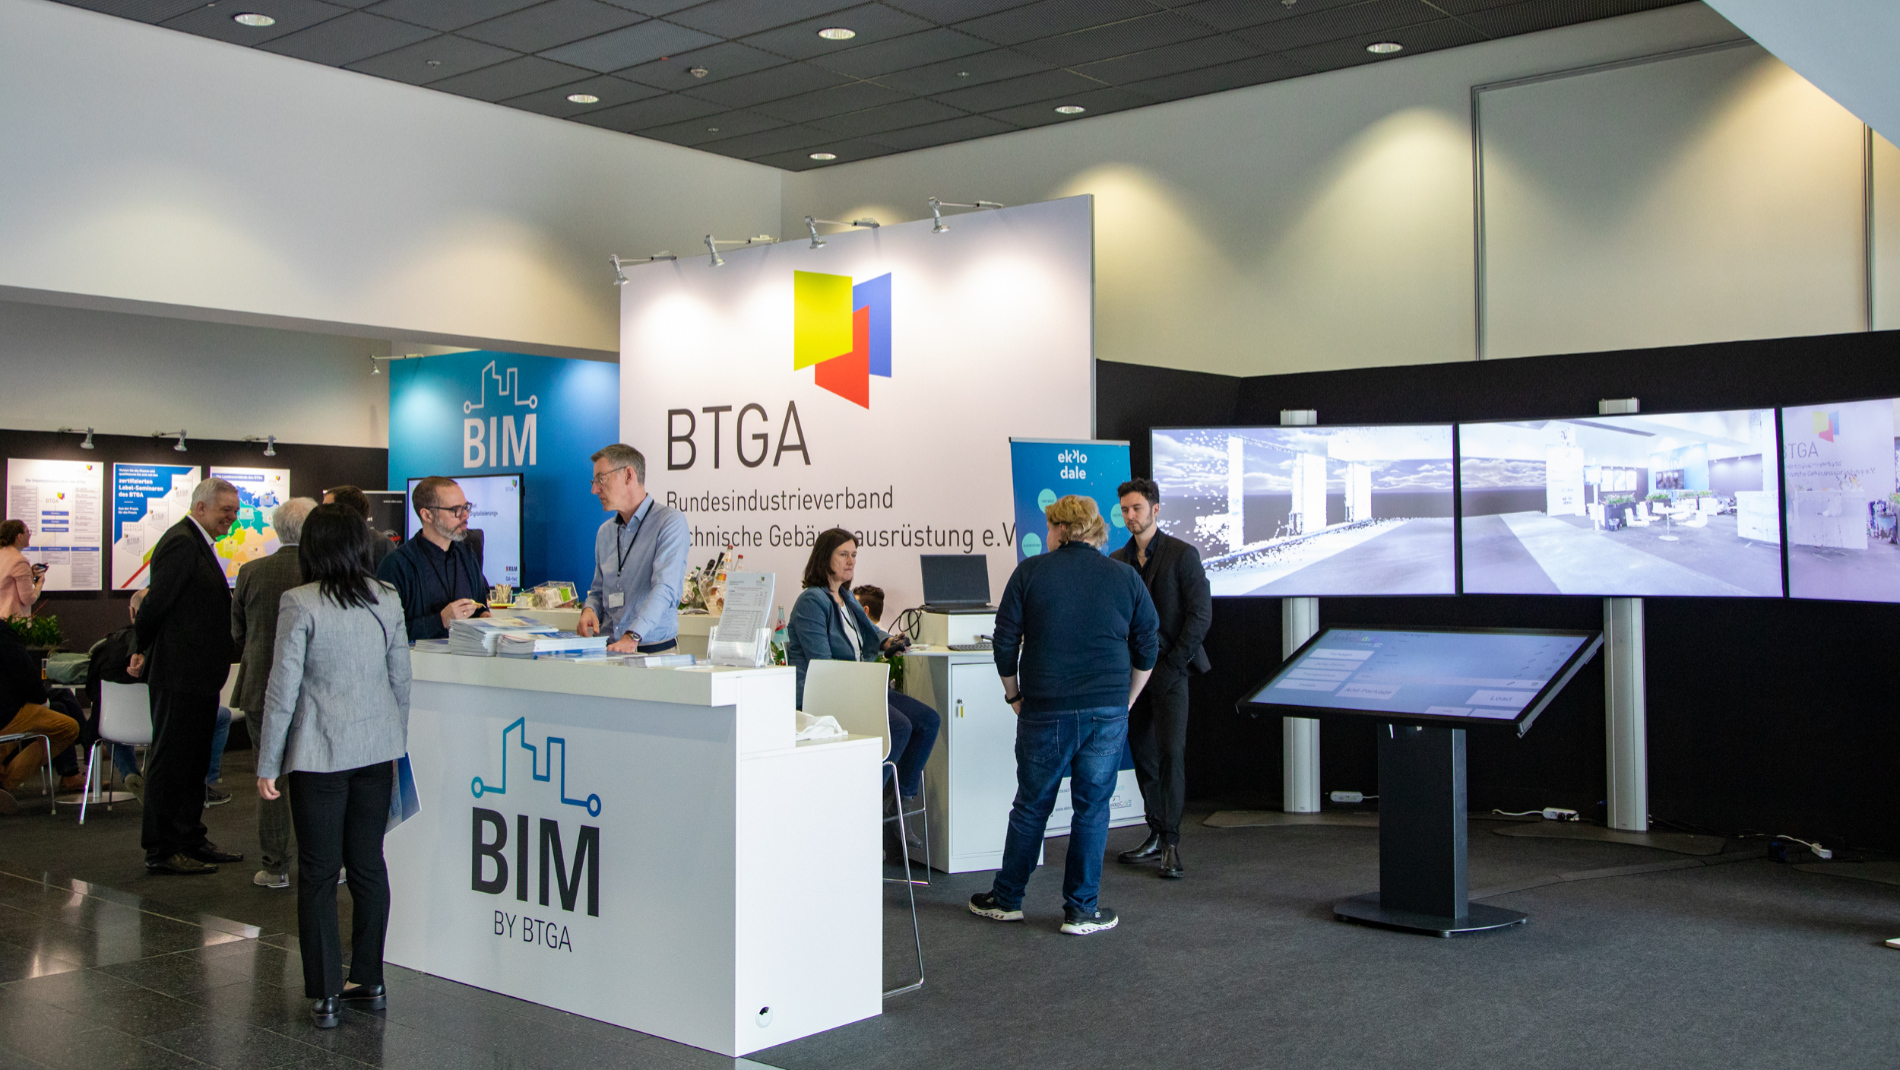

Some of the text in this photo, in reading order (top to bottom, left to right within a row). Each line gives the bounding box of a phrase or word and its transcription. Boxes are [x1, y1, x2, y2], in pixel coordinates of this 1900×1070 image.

[463, 413, 537, 469] BIM
[667, 400, 811, 471] BTGA
[1060, 465, 1087, 480] dale
[666, 485, 894, 512] Bundesindustrieverband
[690, 525, 762, 547] hnische
[769, 524, 974, 554] Gebäausrüstung
[471, 806, 600, 918] BIM
[494, 910, 572, 952] BY BTGA
